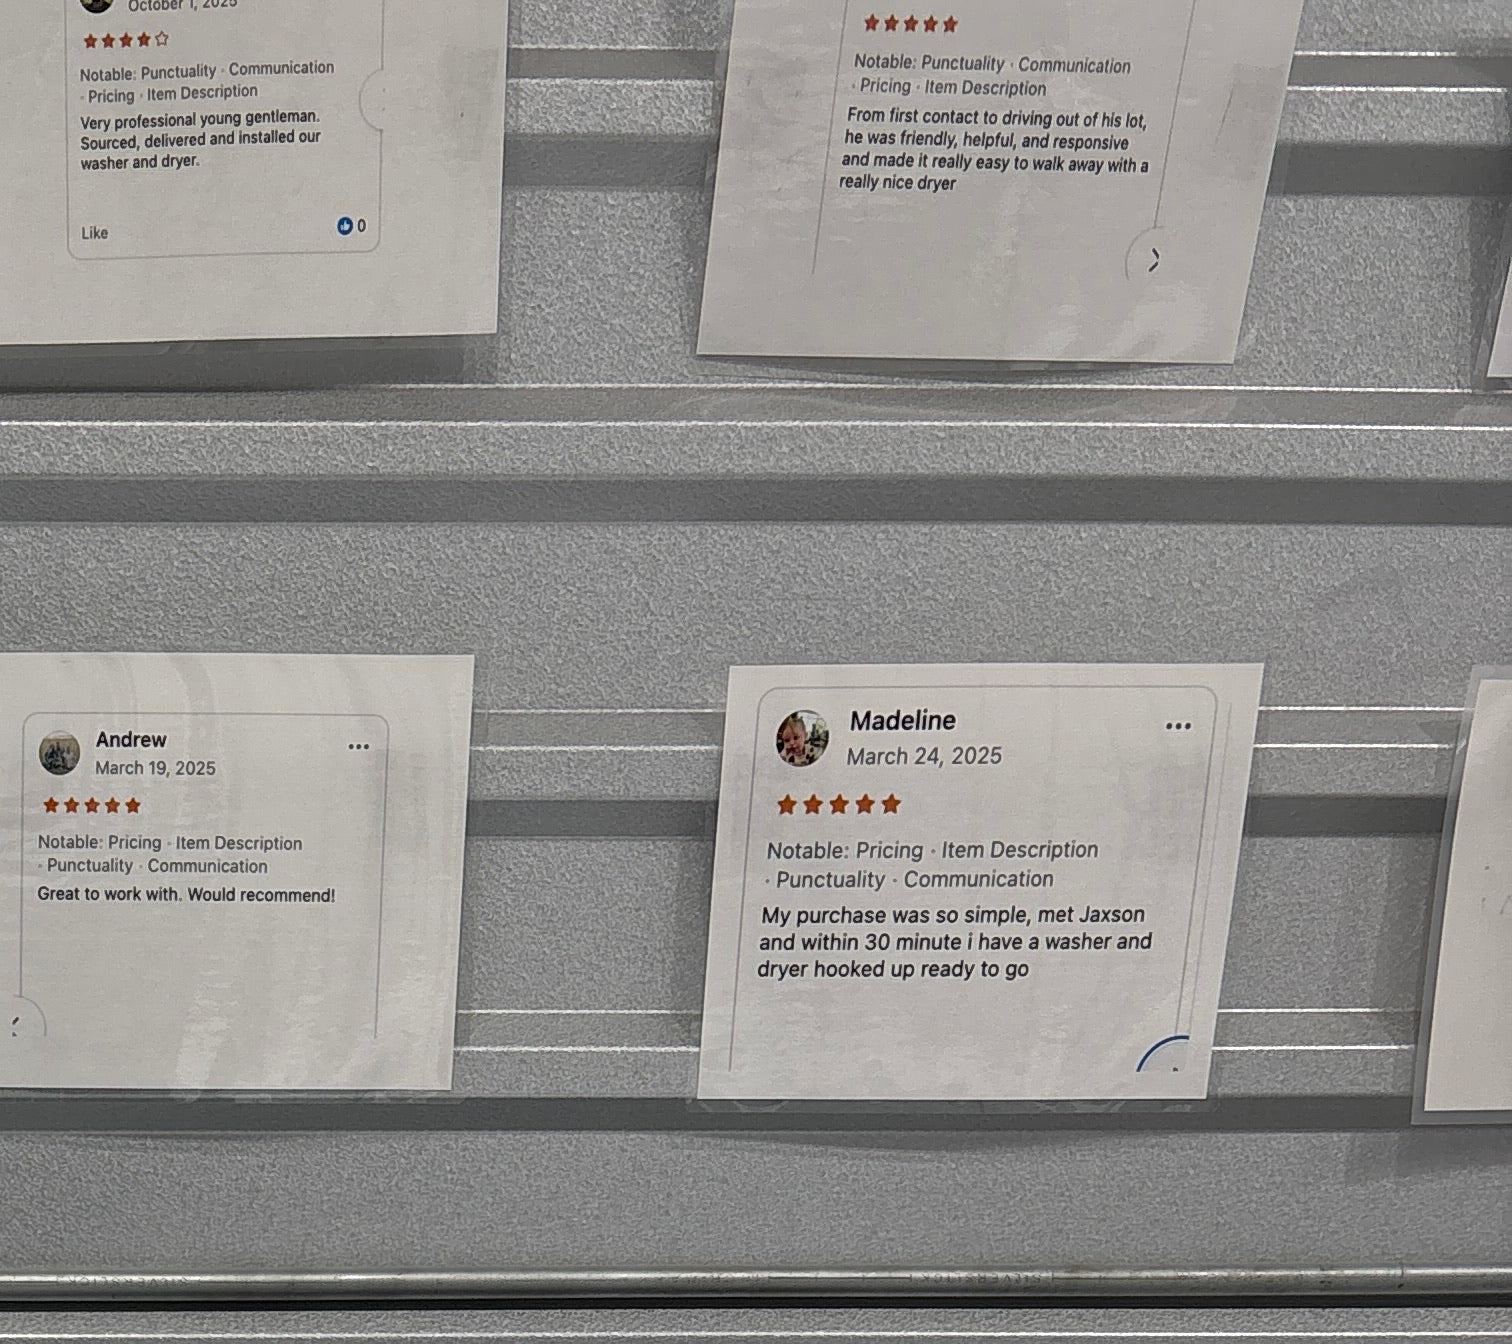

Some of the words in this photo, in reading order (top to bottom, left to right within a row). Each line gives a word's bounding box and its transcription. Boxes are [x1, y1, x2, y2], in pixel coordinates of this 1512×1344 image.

[80, 67, 136, 82] Notable:
[142, 64, 216, 80] Punctuality
[229, 60, 334, 76] Communication
[855, 53, 917, 69] Notable:
[922, 54, 1005, 74] Punctuality
[1019, 56, 1130, 74] Communication
[80, 116, 111, 132] Very
[115, 112, 196, 132] professional
[200, 114, 241, 128] young
[246, 109, 320, 126] gentleman.
[848, 107, 885, 122] From
[890, 107, 918, 123] first
[923, 110, 978, 124] contact
[984, 111, 997, 124] to
[1002, 110, 1052, 129] driving
[1056, 113, 1080, 126] out
[1084, 112, 1098, 127] of
[1102, 112, 1121, 128] his
[1126, 112, 1146, 131] lot,
[81, 156, 129, 170] washer
[133, 154, 157, 169] and
[162, 154, 200, 170] dryer.
[851, 709, 956, 731] Madeline
[96, 731, 167, 747] Andrew
[847, 746, 907, 765] March
[914, 747, 943, 768] 24,
[952, 746, 1002, 764] 2025
[96, 760, 143, 775] March
[149, 761, 170, 778] 19,
[176, 761, 216, 775] 2025
[38, 886, 80, 900] Great
[85, 888, 99, 900] to
[104, 886, 141, 901] work
[146, 887, 182, 901] with.
[188, 887, 235, 901] Would
[241, 888, 335, 903] recommend!
[762, 907, 791, 927] My
[797, 906, 886, 927] purchase
[893, 910, 930, 923] was
[936, 910, 958, 923] so
[965, 905, 1031, 927] simple,
[1038, 906, 1074, 922] met
[1079, 906, 1144, 922] Jaxson
